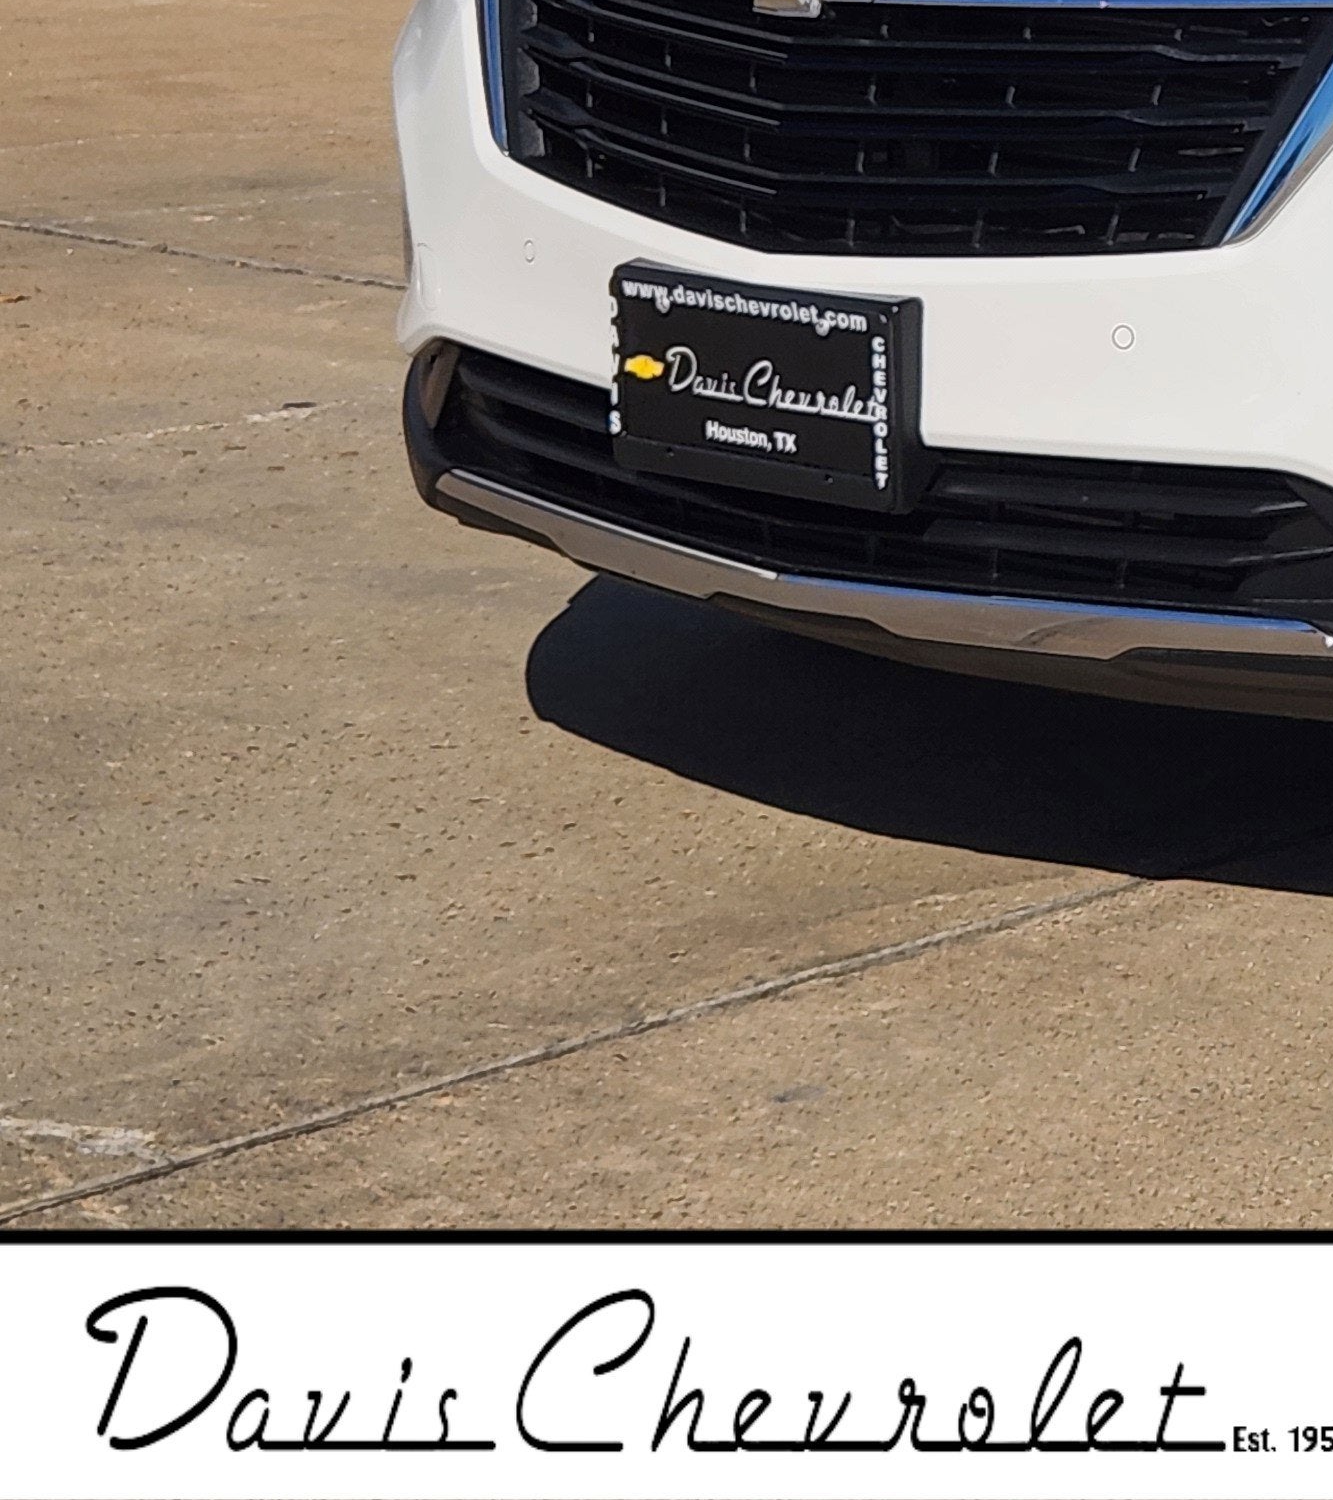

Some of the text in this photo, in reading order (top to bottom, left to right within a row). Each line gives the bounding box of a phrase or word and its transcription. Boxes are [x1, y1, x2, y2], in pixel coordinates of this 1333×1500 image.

[621, 279, 868, 334] www.davischevrolet.com
[666, 346, 880, 423] Davis Chevrolet
[871, 336, 889, 490] CHEVROLET
[705, 420, 798, 453] Houston, TX
